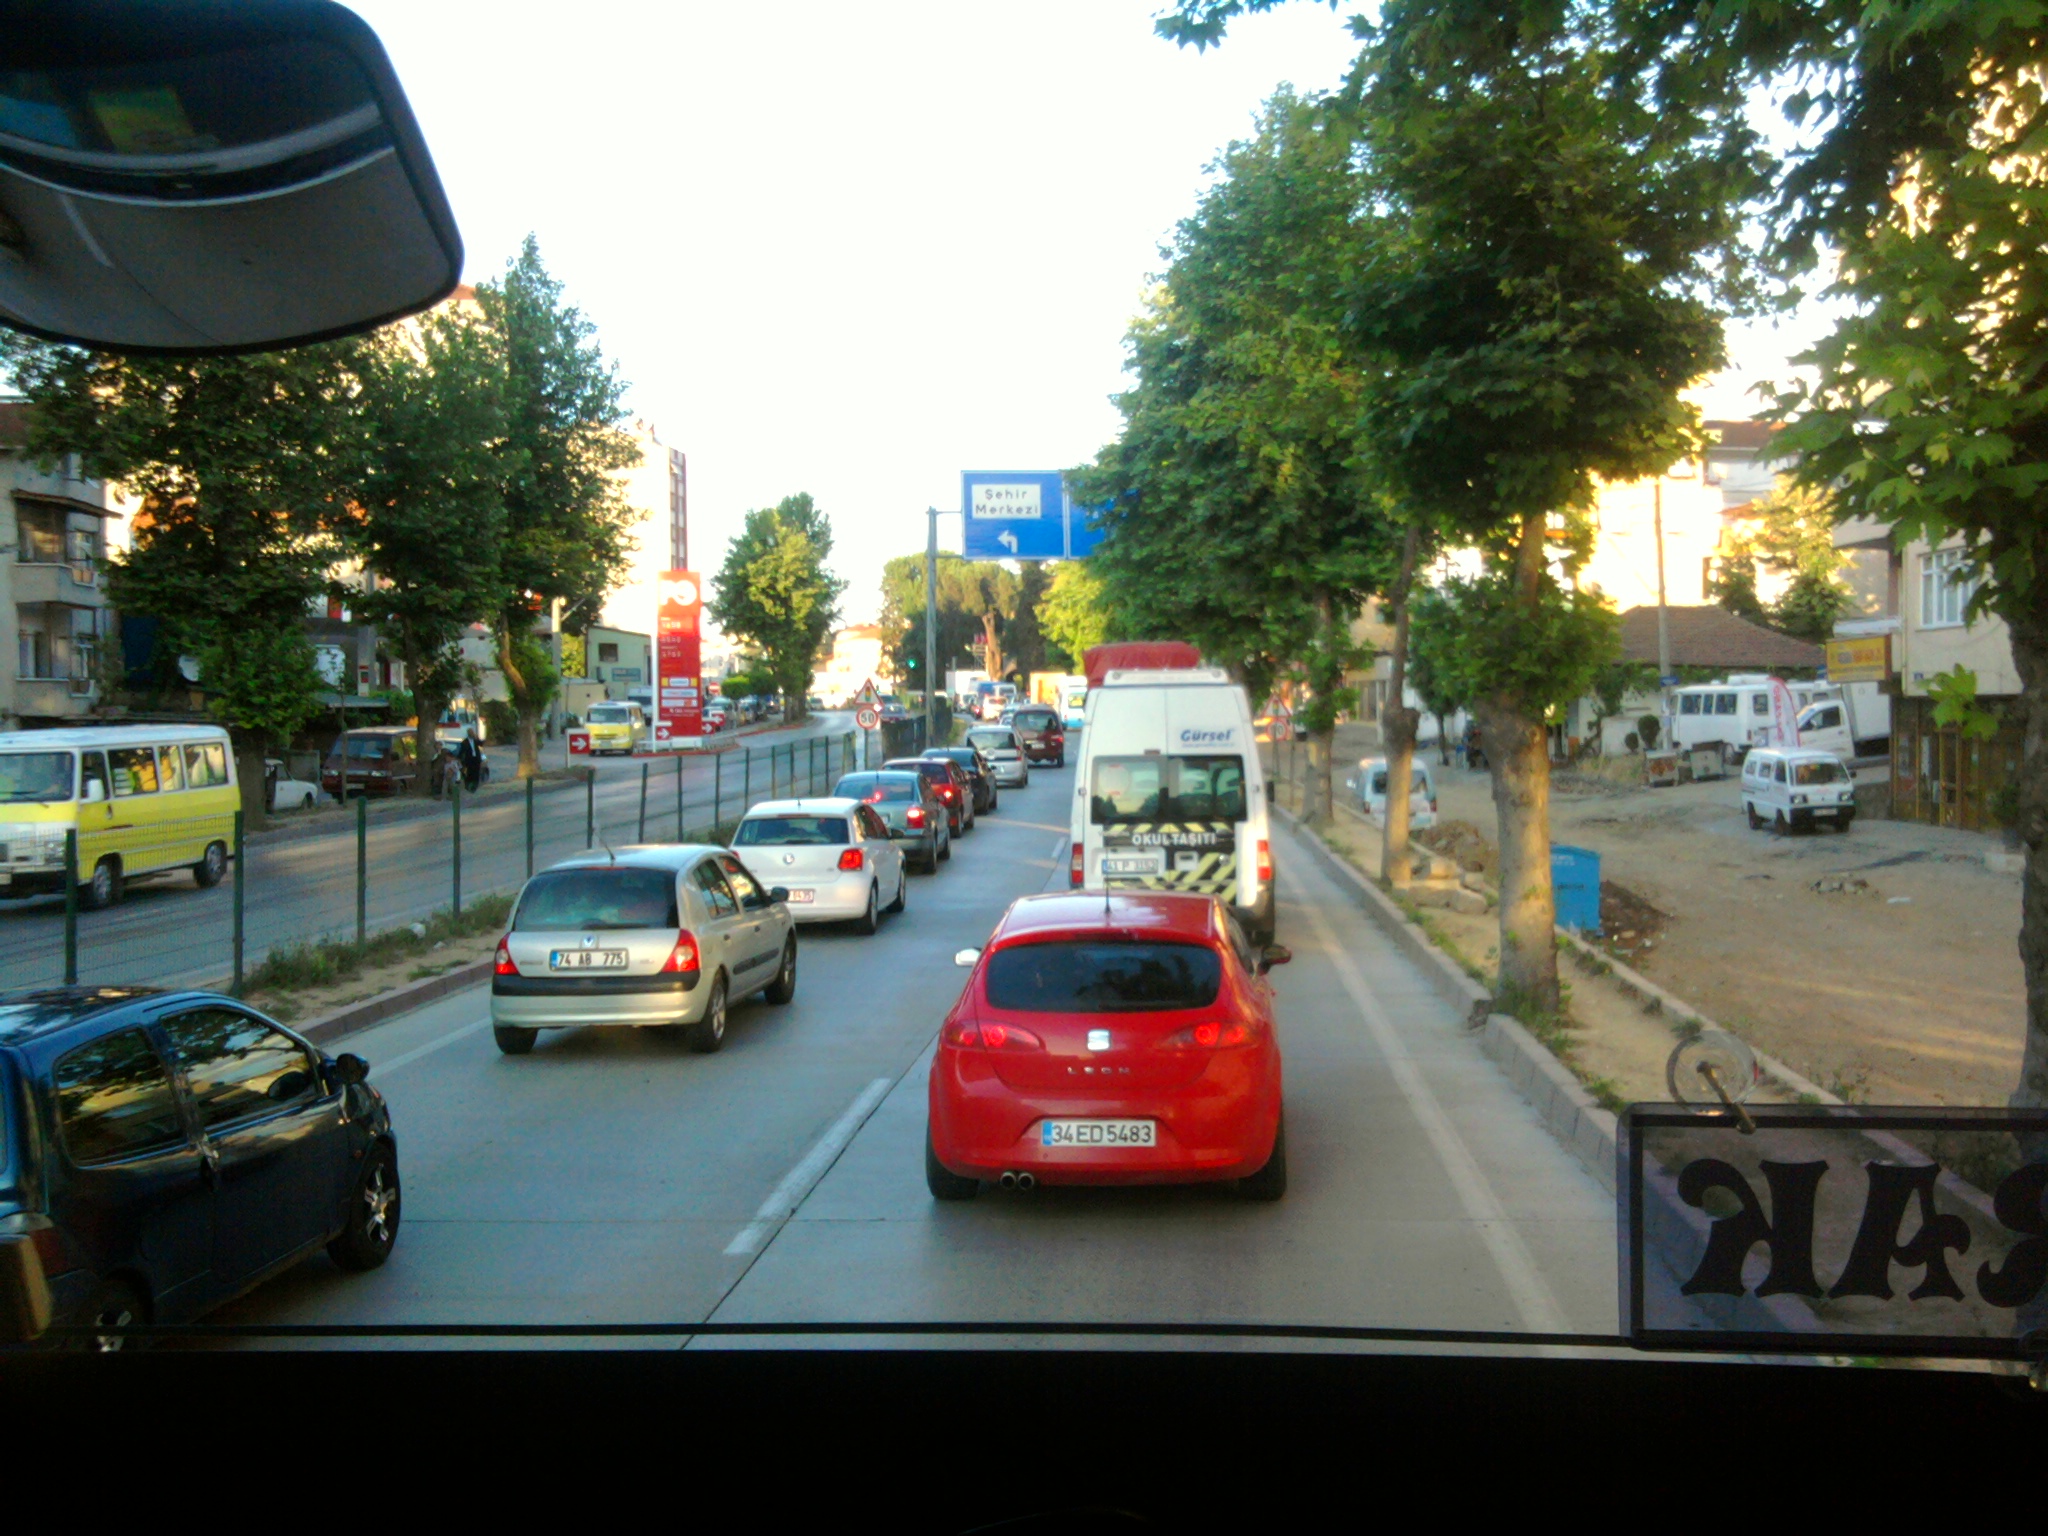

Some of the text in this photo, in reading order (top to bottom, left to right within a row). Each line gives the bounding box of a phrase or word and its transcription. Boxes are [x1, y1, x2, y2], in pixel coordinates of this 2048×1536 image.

[985, 488, 1027, 500] Şehir
[975, 504, 1038, 514] Merkezi
[860, 713, 875, 724] 50
[1180, 728, 1232, 742] Gürsel
[1132, 833, 1217, 848] OKUL TAŞITI
[558, 953, 571, 966] 74
[603, 952, 624, 965] 775
